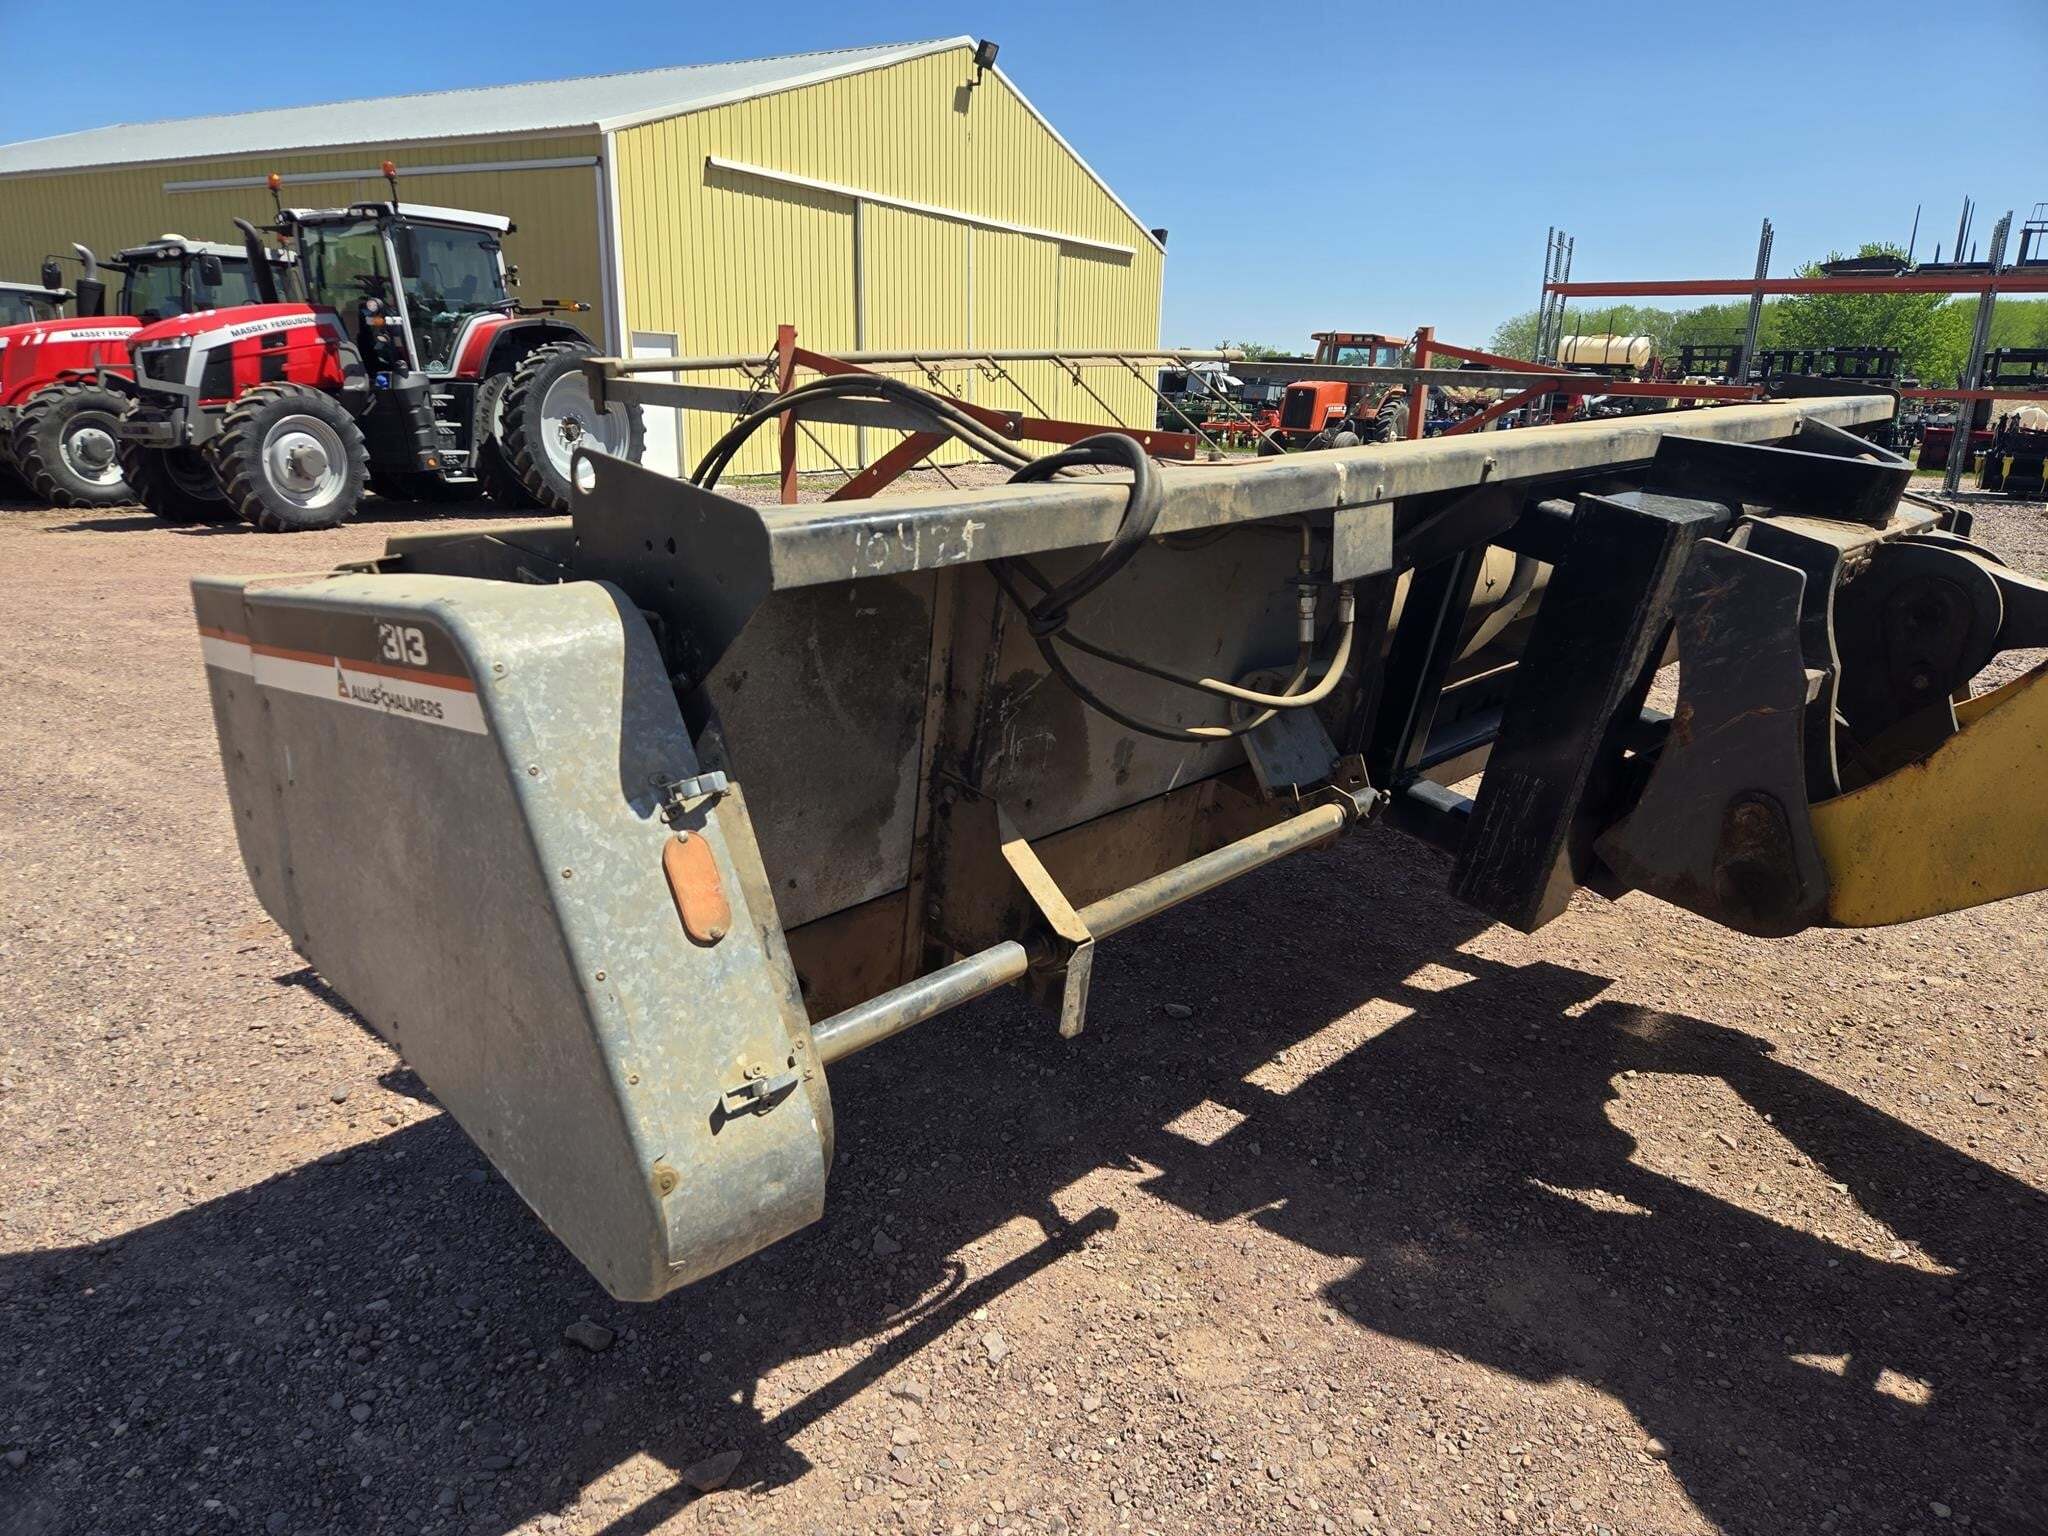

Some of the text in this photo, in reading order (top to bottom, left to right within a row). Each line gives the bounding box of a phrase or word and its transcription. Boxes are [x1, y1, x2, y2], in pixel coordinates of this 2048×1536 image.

[230, 317, 315, 337] MASSEY FERGUSON
[378, 623, 429, 666] 313
